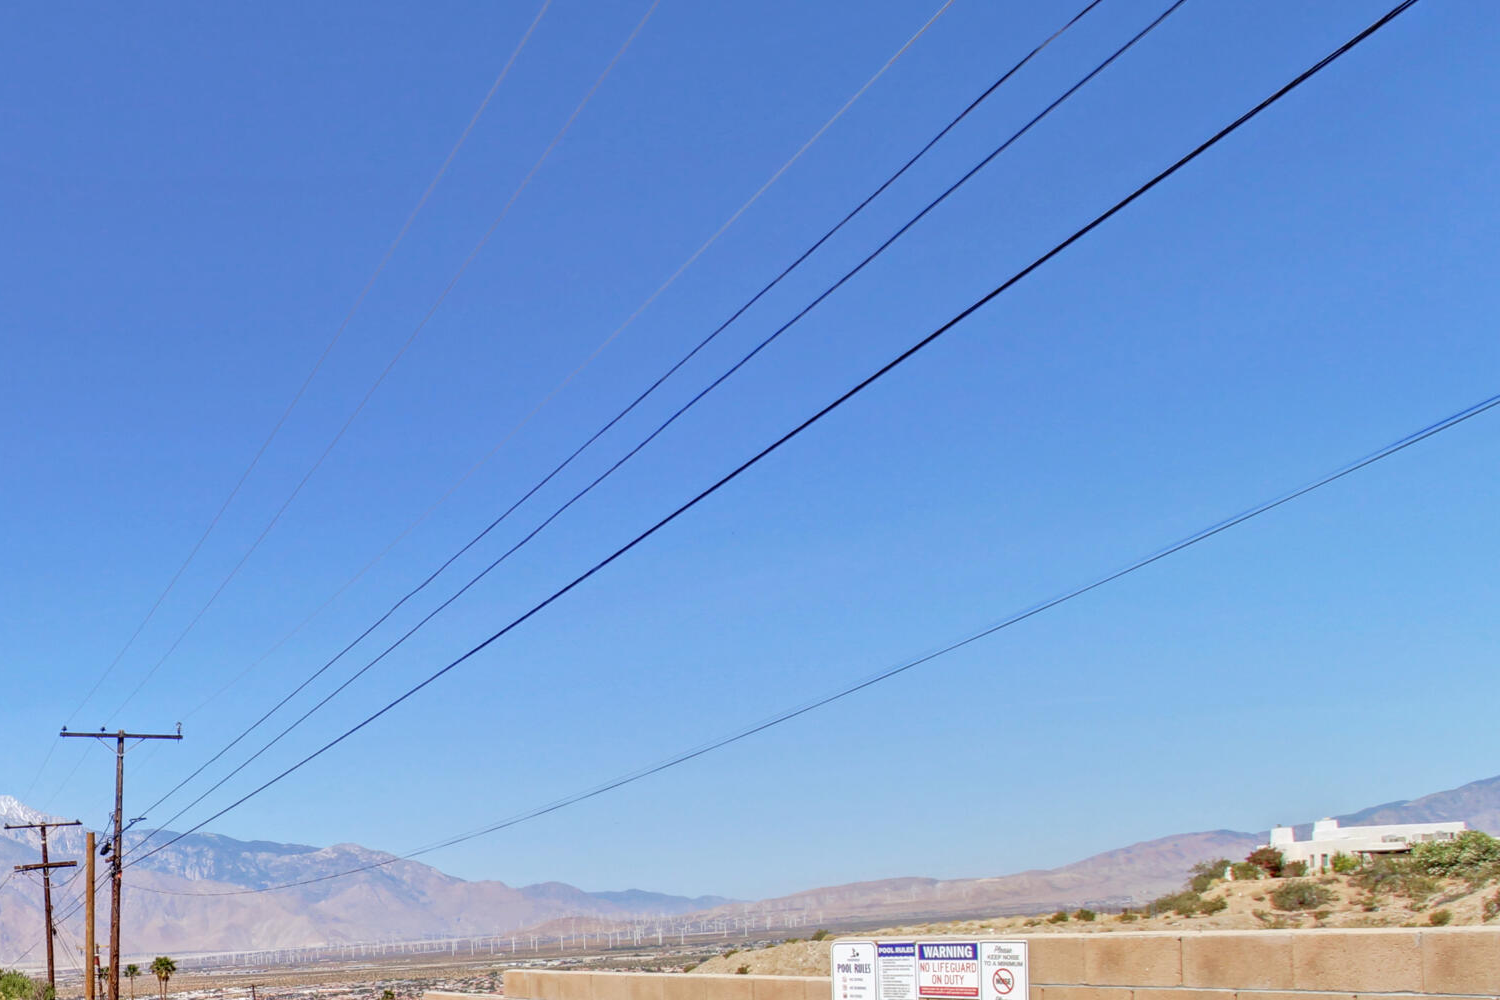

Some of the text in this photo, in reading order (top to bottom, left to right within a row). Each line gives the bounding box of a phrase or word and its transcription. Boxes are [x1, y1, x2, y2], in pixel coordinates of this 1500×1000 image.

[923, 946, 972, 958] WARNING
[837, 964, 871, 973] POOL RULES
[920, 962, 976, 972] NO LIFEGUARD
[932, 975, 964, 984] ON DUTY
